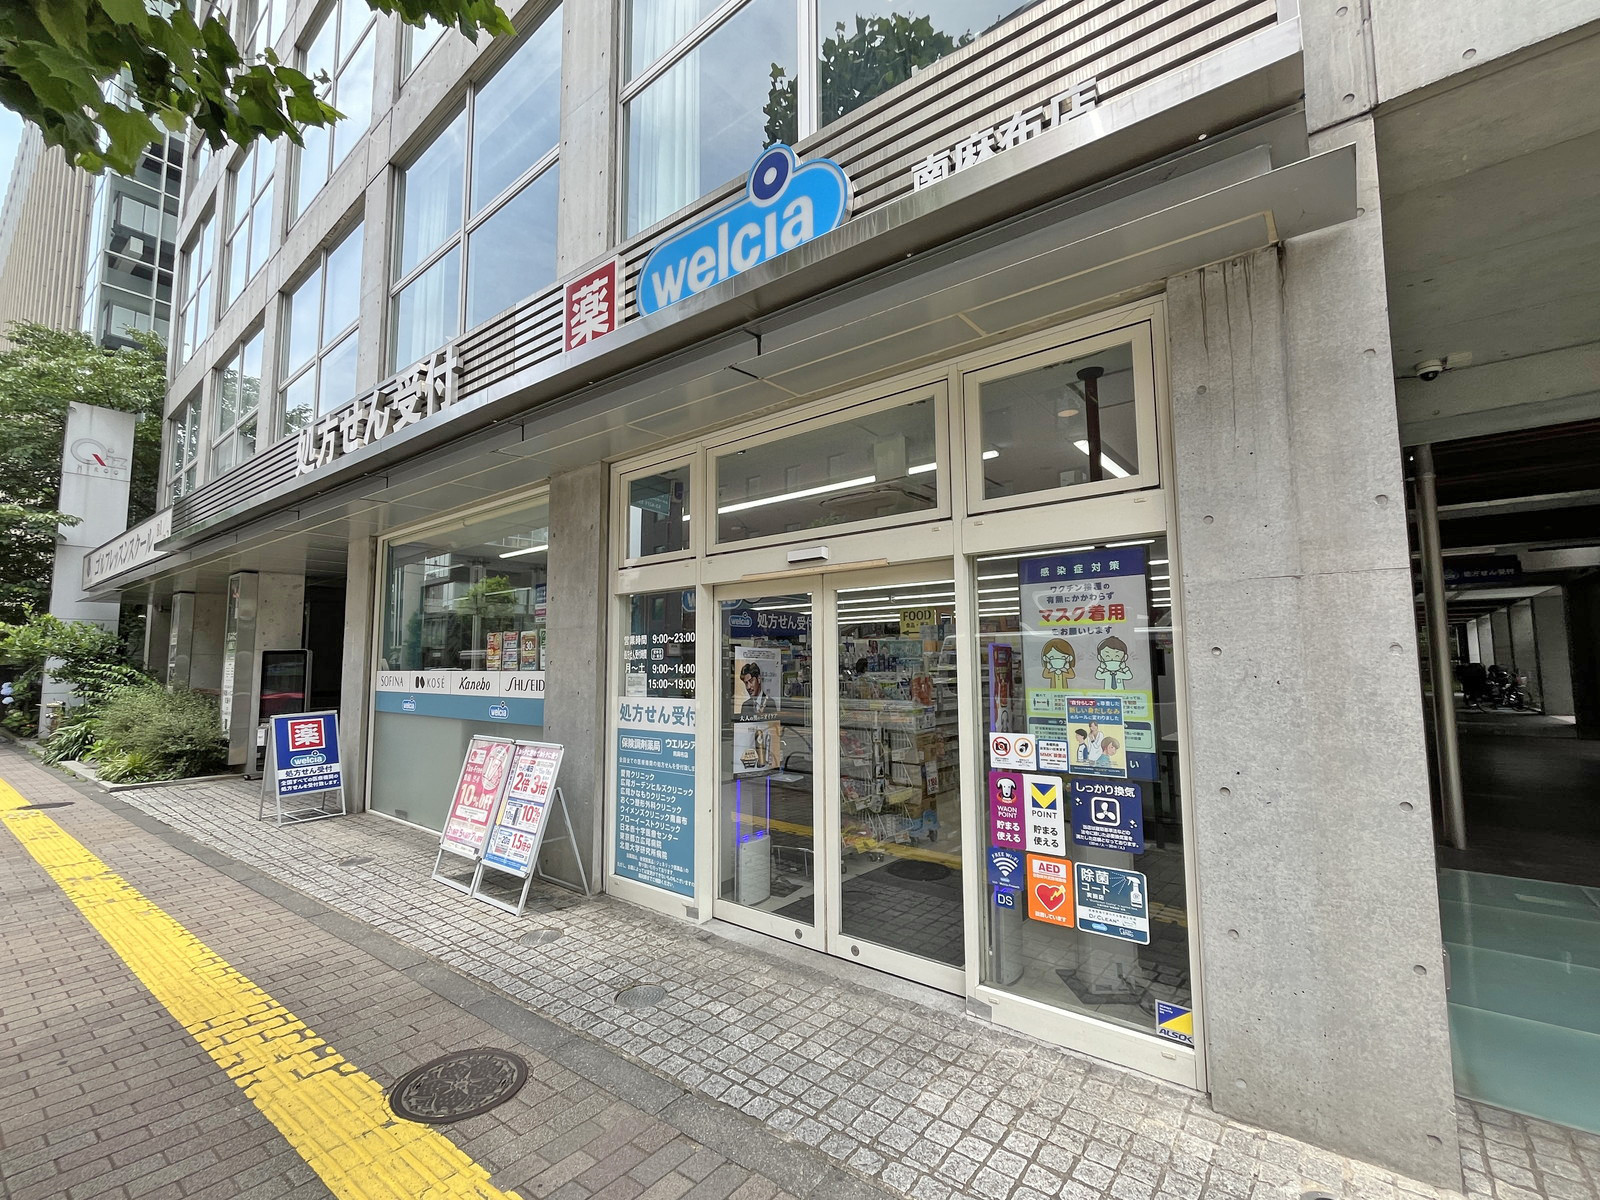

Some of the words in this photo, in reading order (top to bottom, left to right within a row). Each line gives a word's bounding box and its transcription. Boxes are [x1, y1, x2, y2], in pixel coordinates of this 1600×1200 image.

[911, 77, 1097, 191] 南麻布店
[652, 195, 814, 307] welcia
[570, 277, 609, 349] 薬
[295, 345, 460, 477] 処方せん受付
[1040, 560, 1120, 577] 感染症対策
[1046, 591, 1114, 604] 有無にかかわらず
[903, 610, 931, 621] FOOD
[1039, 603, 1125, 622] マスク着用
[380, 675, 404, 687] SOFINA
[426, 675, 445, 689] KOSÉ
[458, 676, 491, 691] Kanebo
[620, 703, 696, 727] 処方せん受付
[294, 723, 320, 746] 薬
[294, 755, 323, 765] welcia
[285, 765, 332, 777] 処方せん受付
[620, 778, 693, 796] 広尾ガーデンヒルズクリニック
[1075, 781, 1136, 798] しっかり換気
[997, 804, 1017, 812] WAON
[1032, 810, 1057, 819] POINT
[620, 814, 680, 833] フローイーストクリニック
[996, 820, 1020, 831] 貯まる
[1034, 825, 1058, 836] 貯まる
[620, 822, 679, 841] 日本赤十字医療センター
[996, 831, 1021, 843] 使える
[1034, 836, 1059, 848] 使える
[1038, 862, 1061, 874] AED
[1080, 867, 1110, 885] 除菌
[1081, 882, 1111, 895] コート
[997, 893, 1013, 906] DS
[1159, 1028, 1193, 1044] ALSOK
